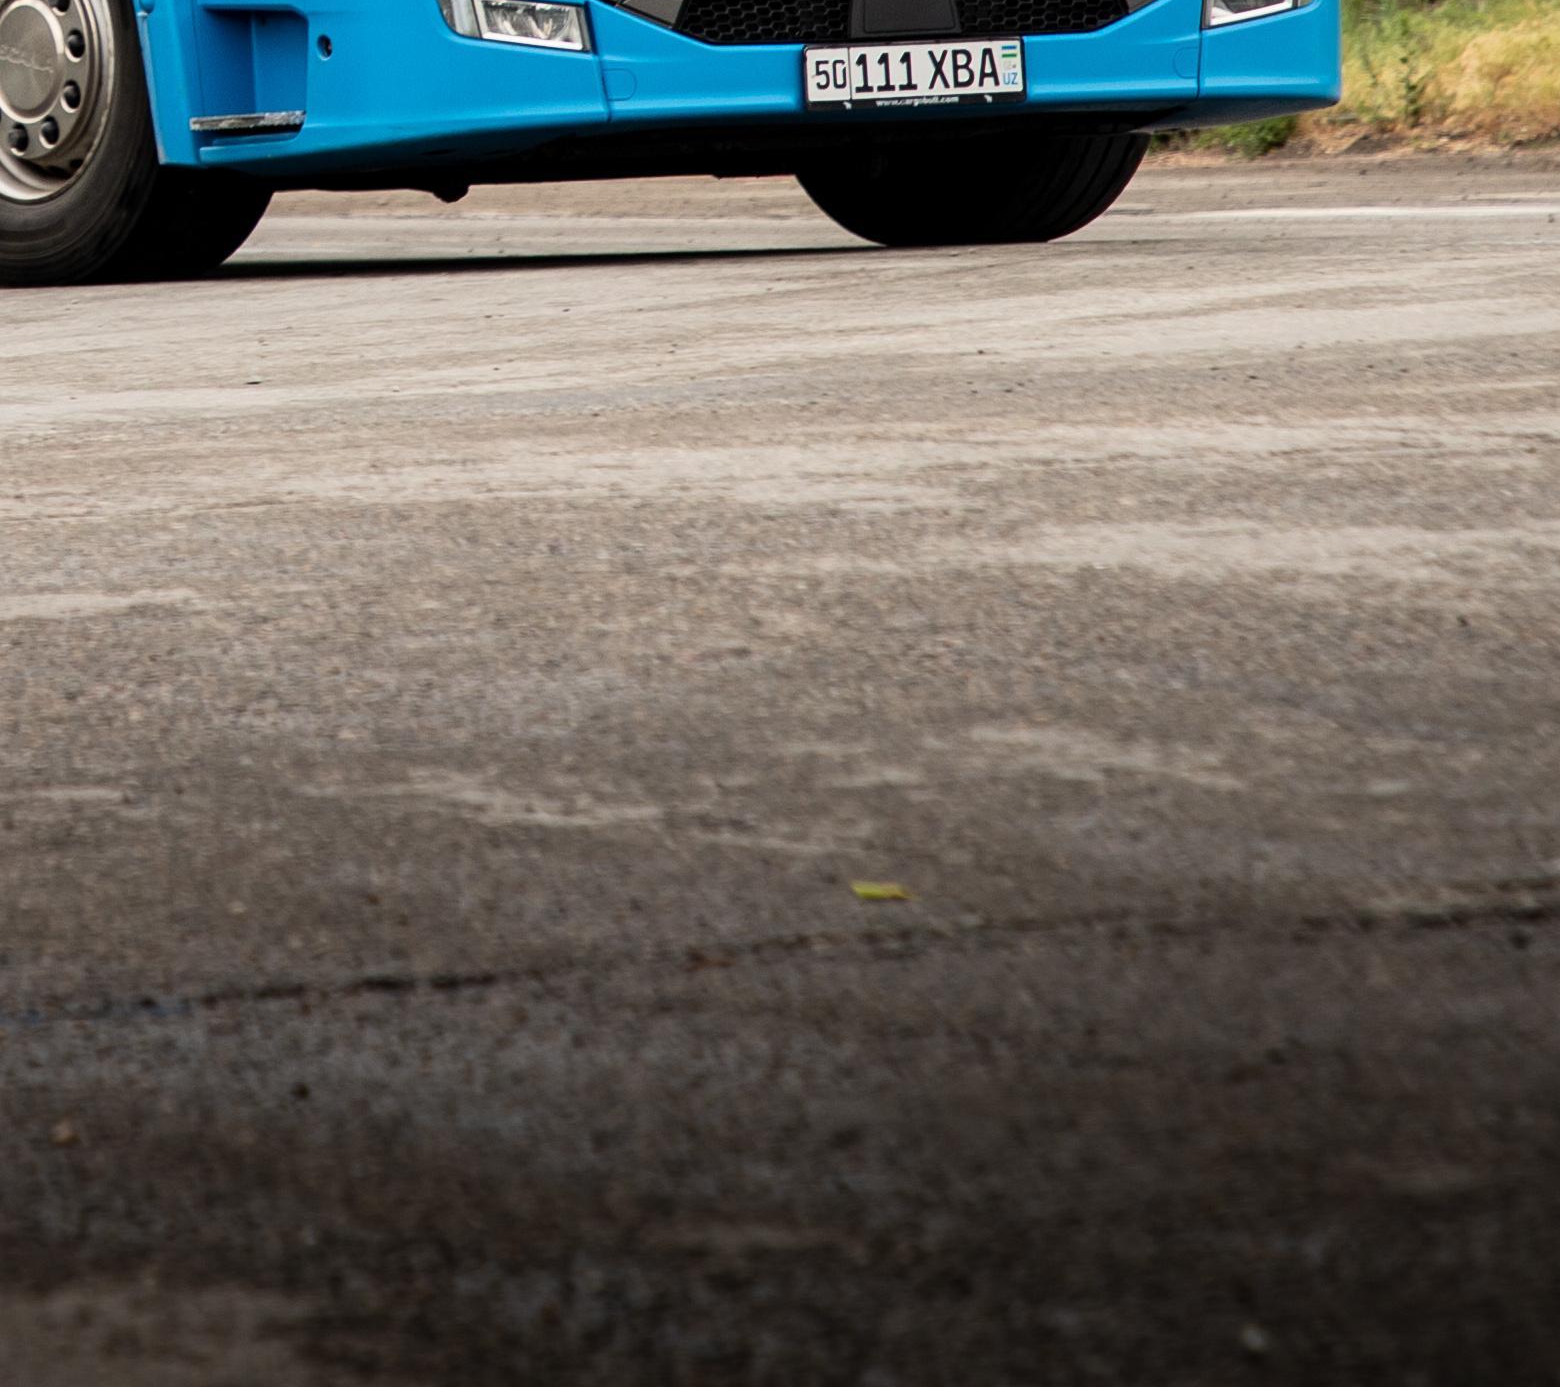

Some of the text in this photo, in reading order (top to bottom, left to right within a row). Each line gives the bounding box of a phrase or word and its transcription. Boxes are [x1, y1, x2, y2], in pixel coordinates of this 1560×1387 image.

[814, 47, 1001, 94] 50 111 XBA
[1002, 71, 1019, 85] UZ
